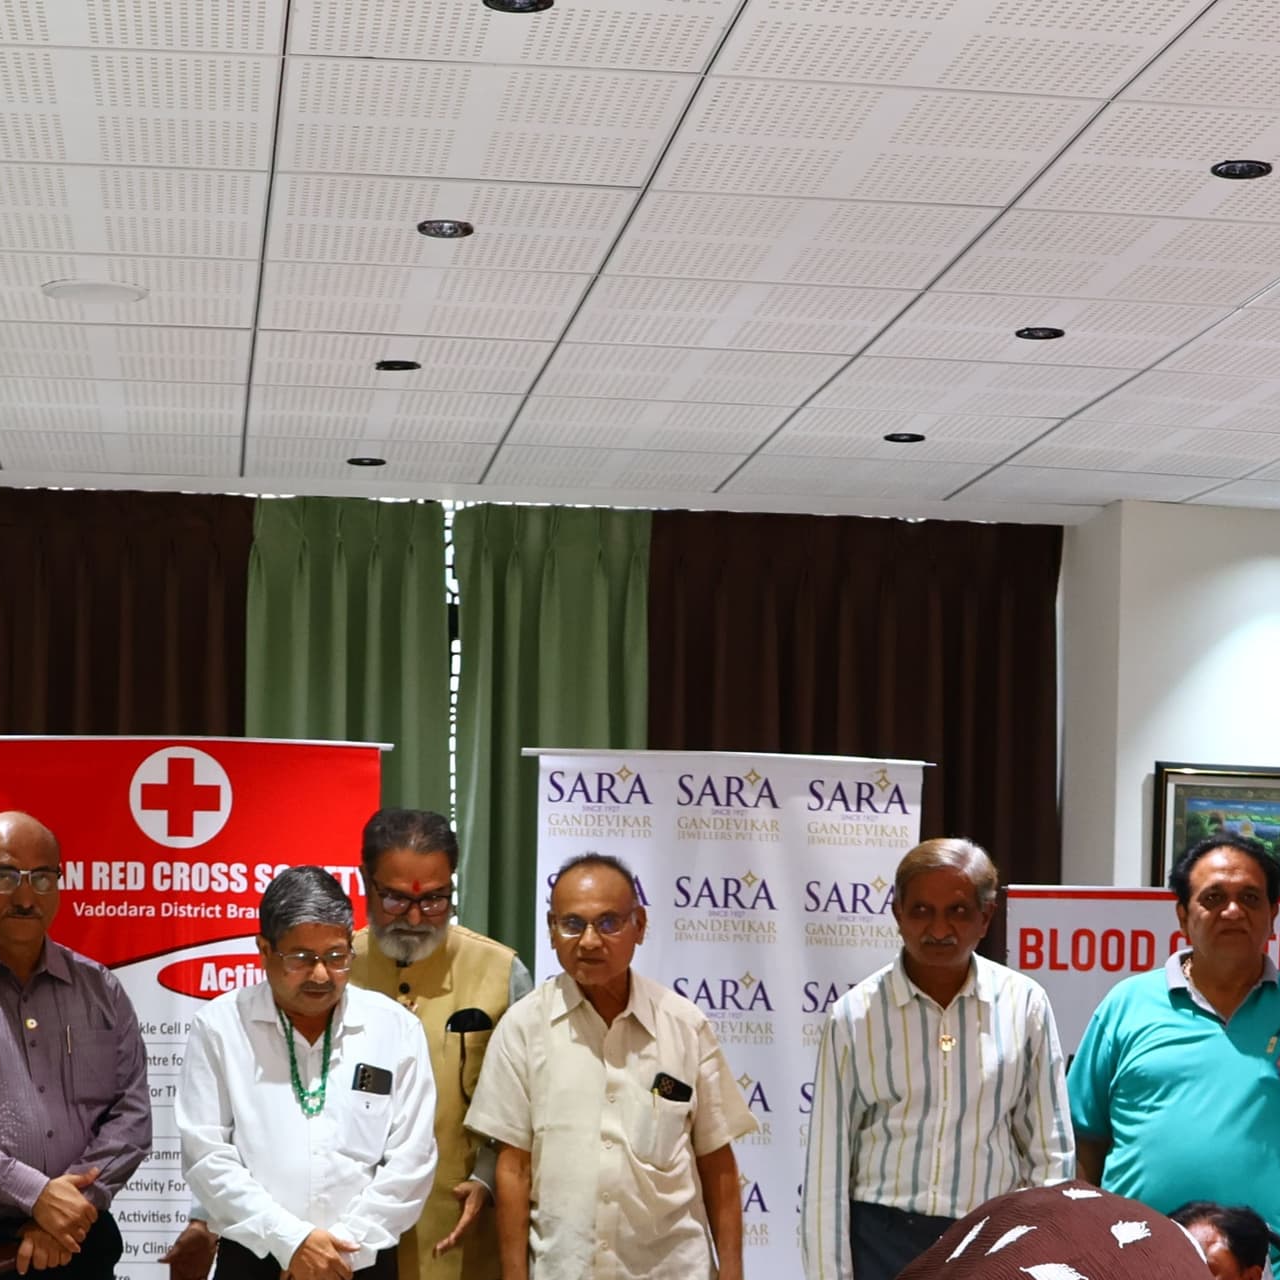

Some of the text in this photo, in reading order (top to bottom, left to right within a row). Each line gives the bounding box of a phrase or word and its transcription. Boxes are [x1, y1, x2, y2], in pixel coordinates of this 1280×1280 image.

[548, 771, 654, 805] SARA
[677, 774, 782, 809] SARA
[807, 779, 910, 815] SARA
[548, 813, 652, 828] GANDEVIKAR
[677, 816, 780, 832] GANDEVIKAR
[548, 827, 602, 838] JEWELLERS
[807, 821, 910, 838] GANDEVIKAR
[92, 861, 145, 891] RED
[152, 862, 248, 893] CROSS
[674, 876, 779, 910] SARA
[73, 901, 156, 917] Vadodara
[160, 902, 222, 918] District
[674, 918, 777, 933] GANDEVIKAR
[1019, 927, 1155, 972] BLOOD
[673, 977, 775, 1011] SARA
[160, 1022, 181, 1035] Cell
[168, 1181, 186, 1191] For
[118, 1210, 171, 1222] Activities
